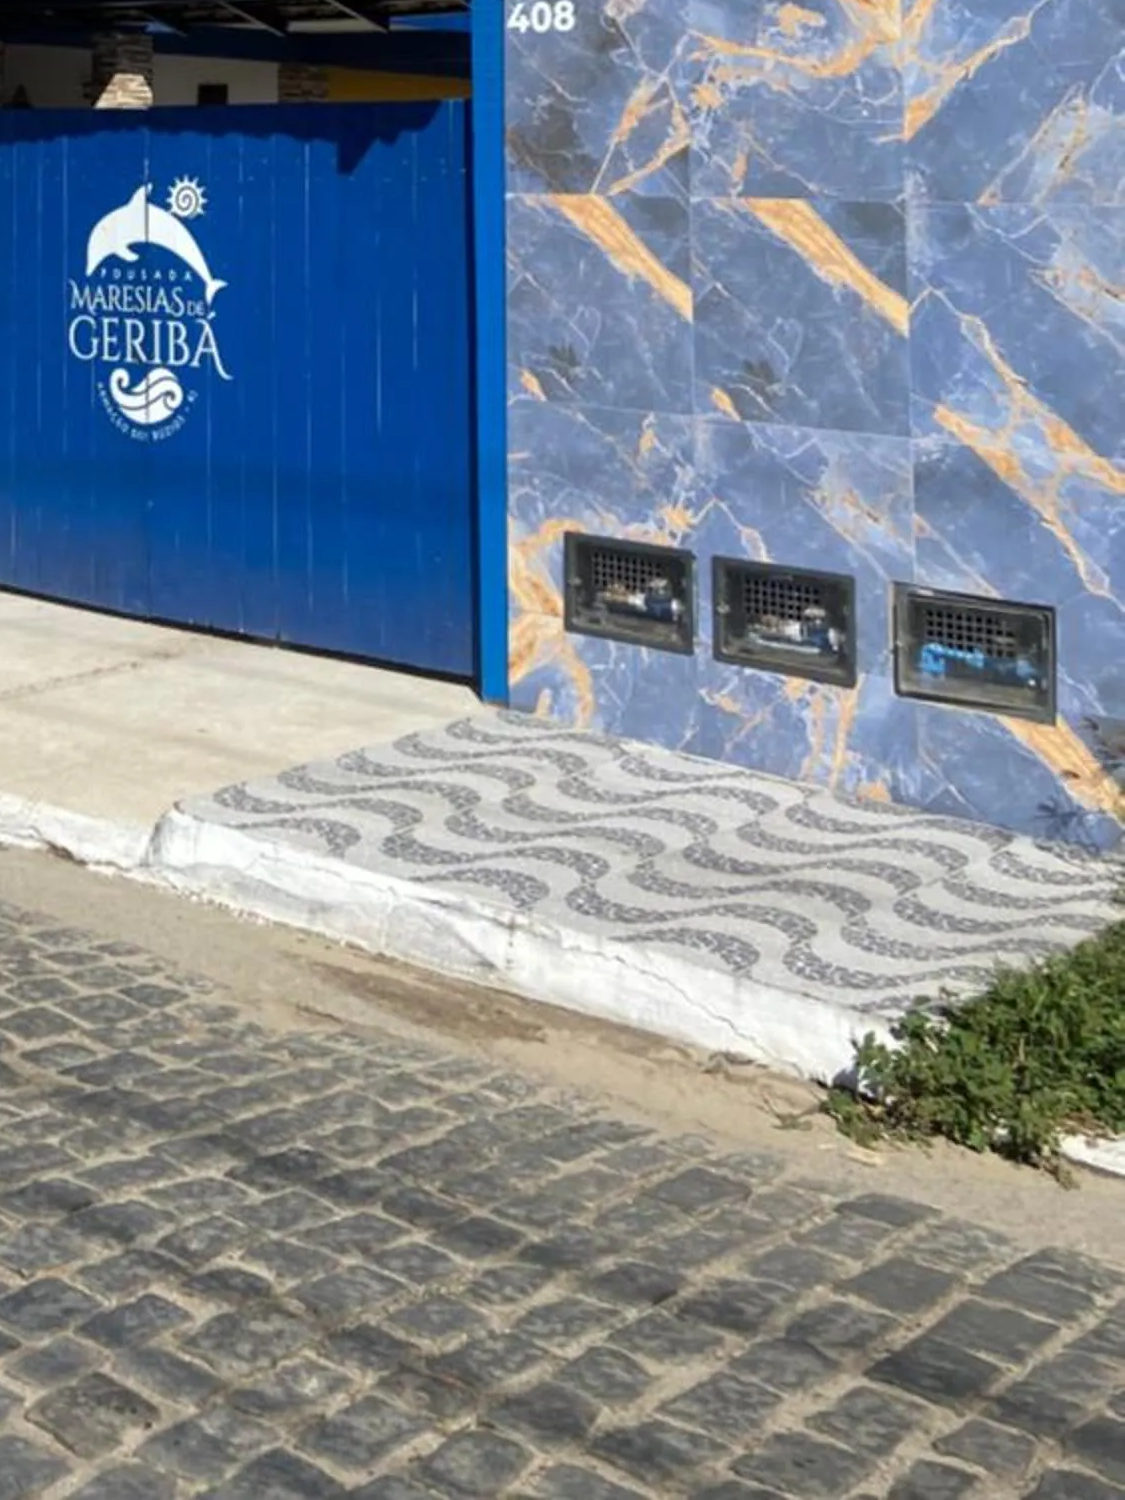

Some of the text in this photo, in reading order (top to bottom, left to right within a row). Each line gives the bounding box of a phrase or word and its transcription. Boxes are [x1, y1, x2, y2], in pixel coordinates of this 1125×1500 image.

[507, 0, 575, 34] 408
[100, 268, 193, 282] POUSADA
[69, 278, 206, 317] MARESIAS DE
[68, 311, 234, 381] GERIBÁ
